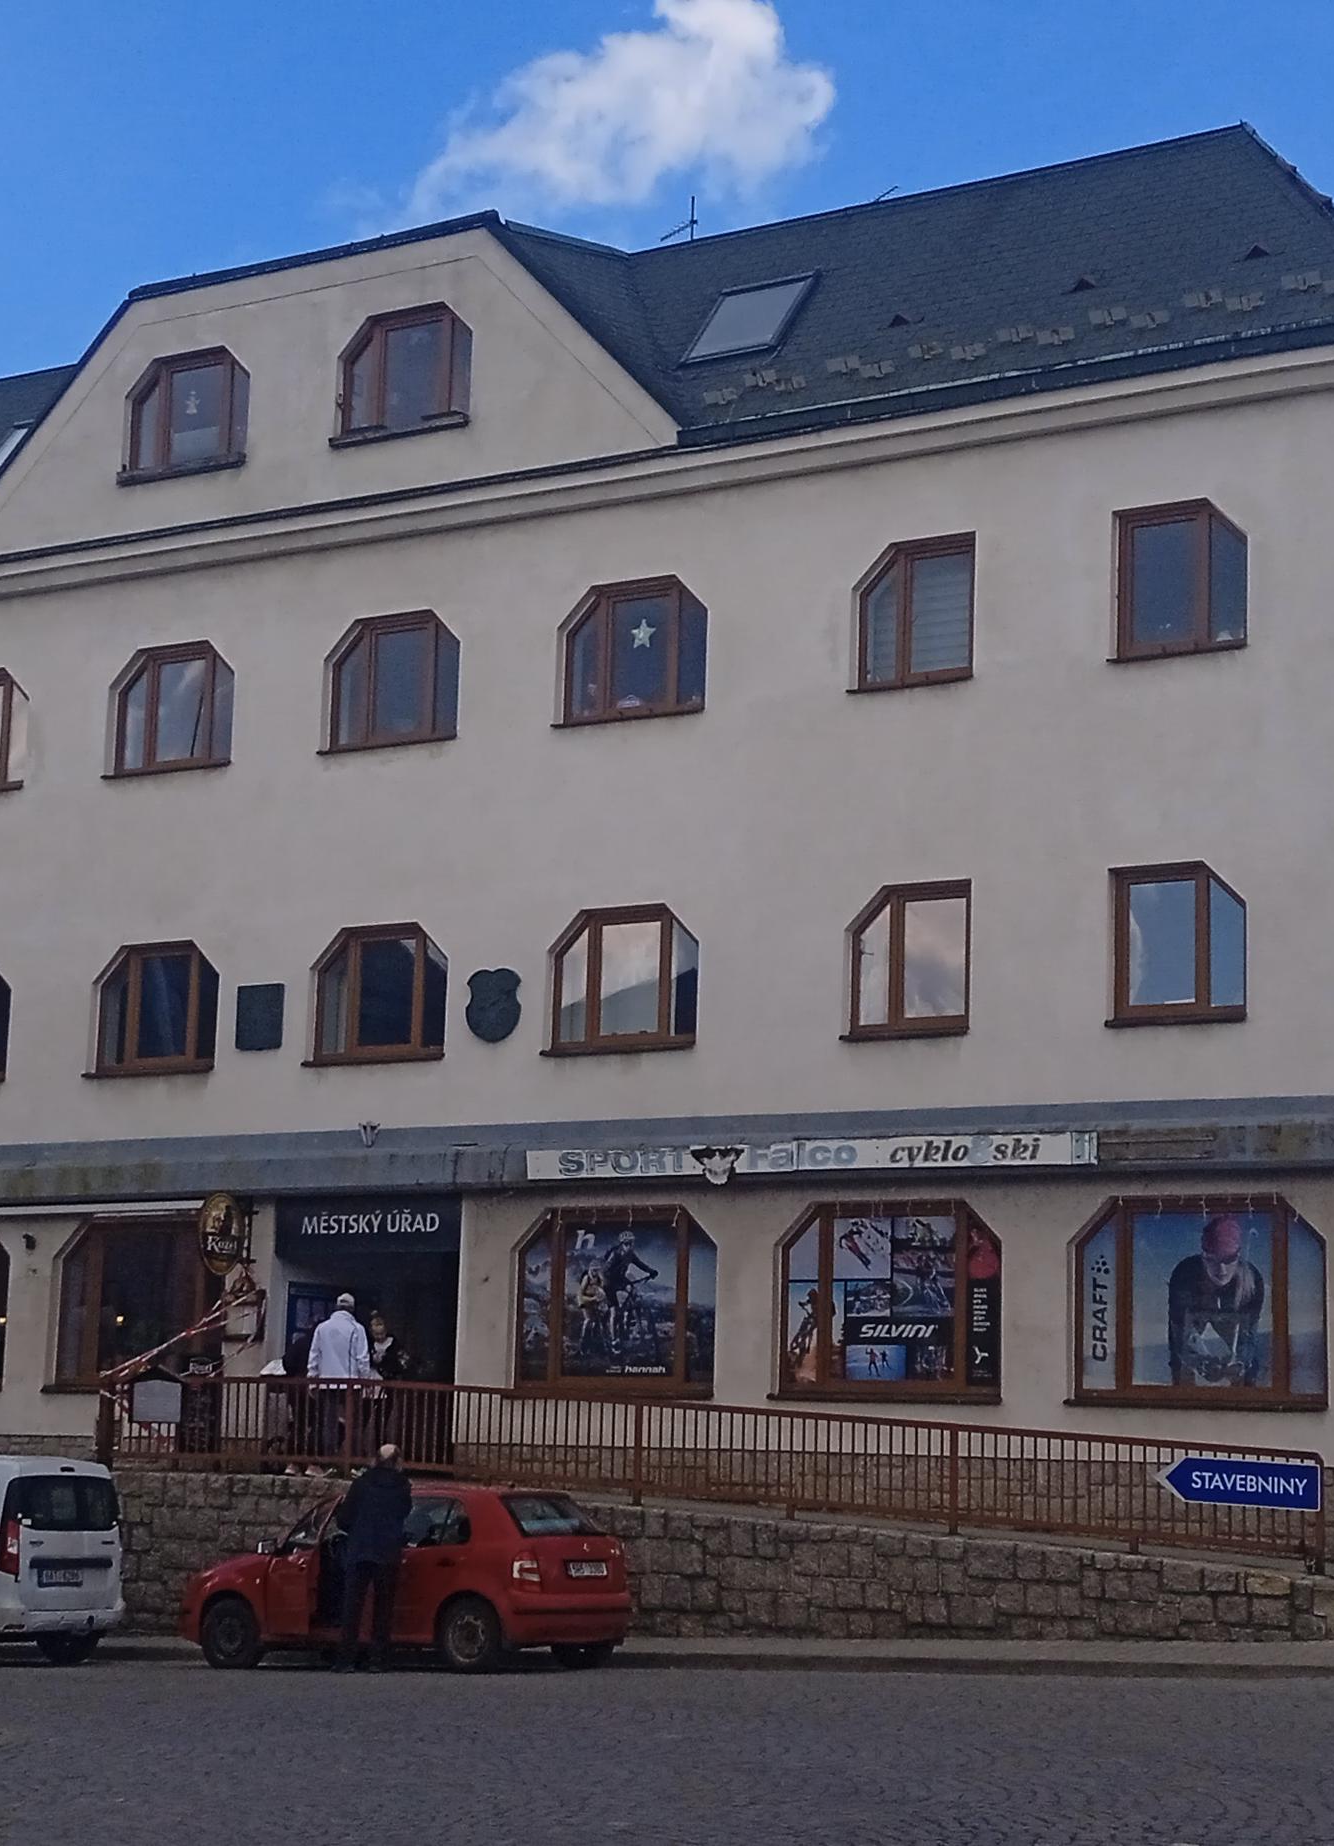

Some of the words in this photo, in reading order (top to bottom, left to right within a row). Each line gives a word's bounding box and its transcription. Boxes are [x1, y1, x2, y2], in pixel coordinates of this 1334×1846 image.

[558, 1148, 689, 1176] SPORT
[301, 1210, 383, 1235] MĚSTSKÝ
[386, 1208, 440, 1233] ÚŘAD
[1092, 1277, 1108, 1362] CRAFT
[1190, 1470, 1308, 1496] STAVEBNINY
